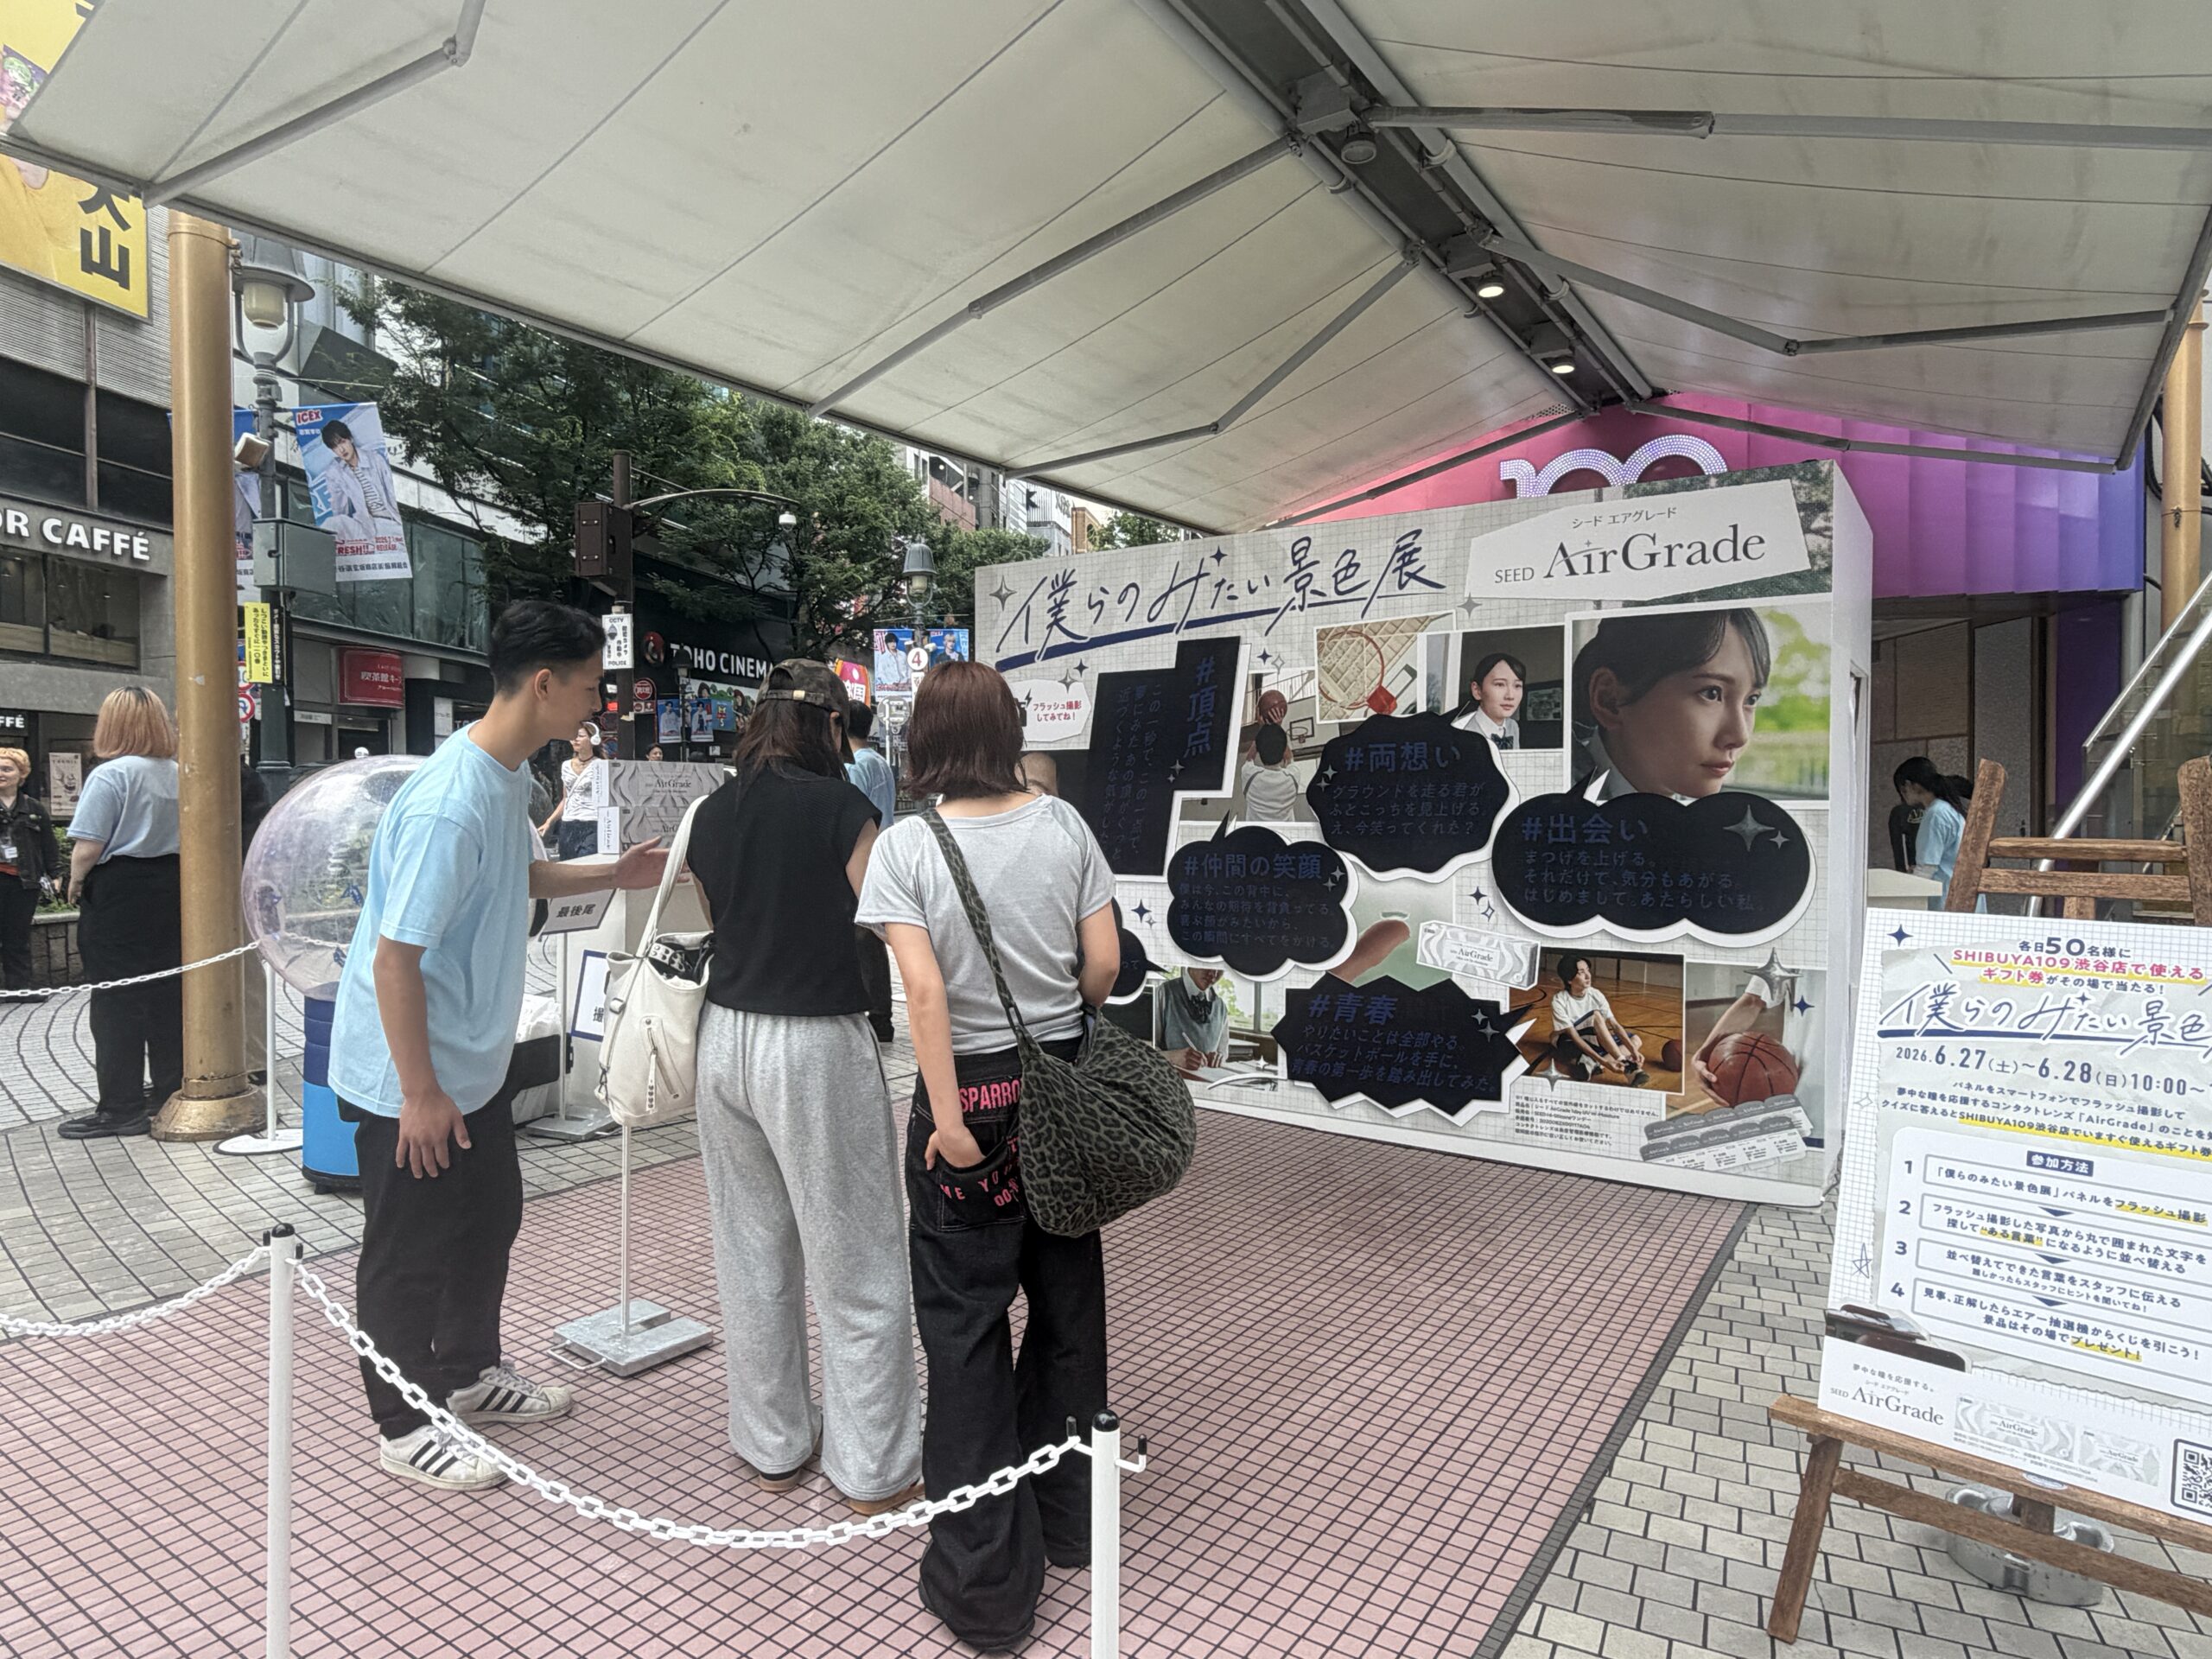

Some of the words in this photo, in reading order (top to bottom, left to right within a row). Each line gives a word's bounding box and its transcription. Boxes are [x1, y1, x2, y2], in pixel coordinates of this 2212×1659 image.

[296, 410, 321, 424] ICEX
[1572, 514, 1603, 529] シード
[1608, 506, 1677, 525] エアグレード
[0, 508, 29, 537] R
[42, 518, 149, 561] CAFFÉ
[1495, 567, 1535, 583] SEED
[1544, 524, 1765, 579] AirGrade
[995, 529, 1446, 659] 僕らのみたい景色展
[720, 652, 773, 679] CINEM
[912, 652, 922, 666] 4
[1033, 701, 1082, 712] フラッシュ撮影
[1036, 712, 1076, 722] してみてね！
[1183, 656, 1217, 759] #頂点
[1344, 741, 1461, 772] #両想い
[1332, 781, 1486, 799] グラウンドを走る君が
[1522, 812, 1649, 844] #出会い
[1185, 853, 1322, 880] #仲間の笑顔
[1524, 850, 1656, 868] まつげを上げる。
[556, 904, 596, 918] 最後尾
[2018, 937, 2132, 959] 各日50名様に
[1953, 949, 2203, 981] SHIBUYA109渋谷店で使える
[1982, 969, 2165, 995] ギフト券がその場で当たる！
[1307, 992, 1399, 1026] #青春
[1878, 982, 2212, 1059] 僕らのみたい景色
[1302, 1025, 1466, 1052] やりたいことは全部やる。
[1953, 1082, 2186, 1121] パネルをスマートフォンでフラッシュ撮影して
[1904, 1160, 1913, 1174] 1
[2031, 1154, 2090, 1175] 参加方法
[1898, 1200, 1911, 1215] 2
[1937, 1166, 2206, 1224] 「僕らのみたい景色展」パネルをフラッシュ撮影
[1933, 1203, 2207, 1265] フラッシュ撮影した写真から丸で囲まれた文字を
[1894, 1241, 1908, 1255] 3
[1891, 1281, 1905, 1298] 4
[1946, 1249, 2181, 1308] 並べ替えてできた言葉をスタッフに伝える
[1923, 1287, 2199, 1360] 見事、正解したらエアー抽選機からくじを引こう！
[1983, 1314, 2141, 1361] 景品はその場でプレゼント！
[1830, 1387, 1849, 1398] SEED
[1852, 1386, 1944, 1426] AirGrade
[1999, 1420, 2039, 1437] AirGrade
